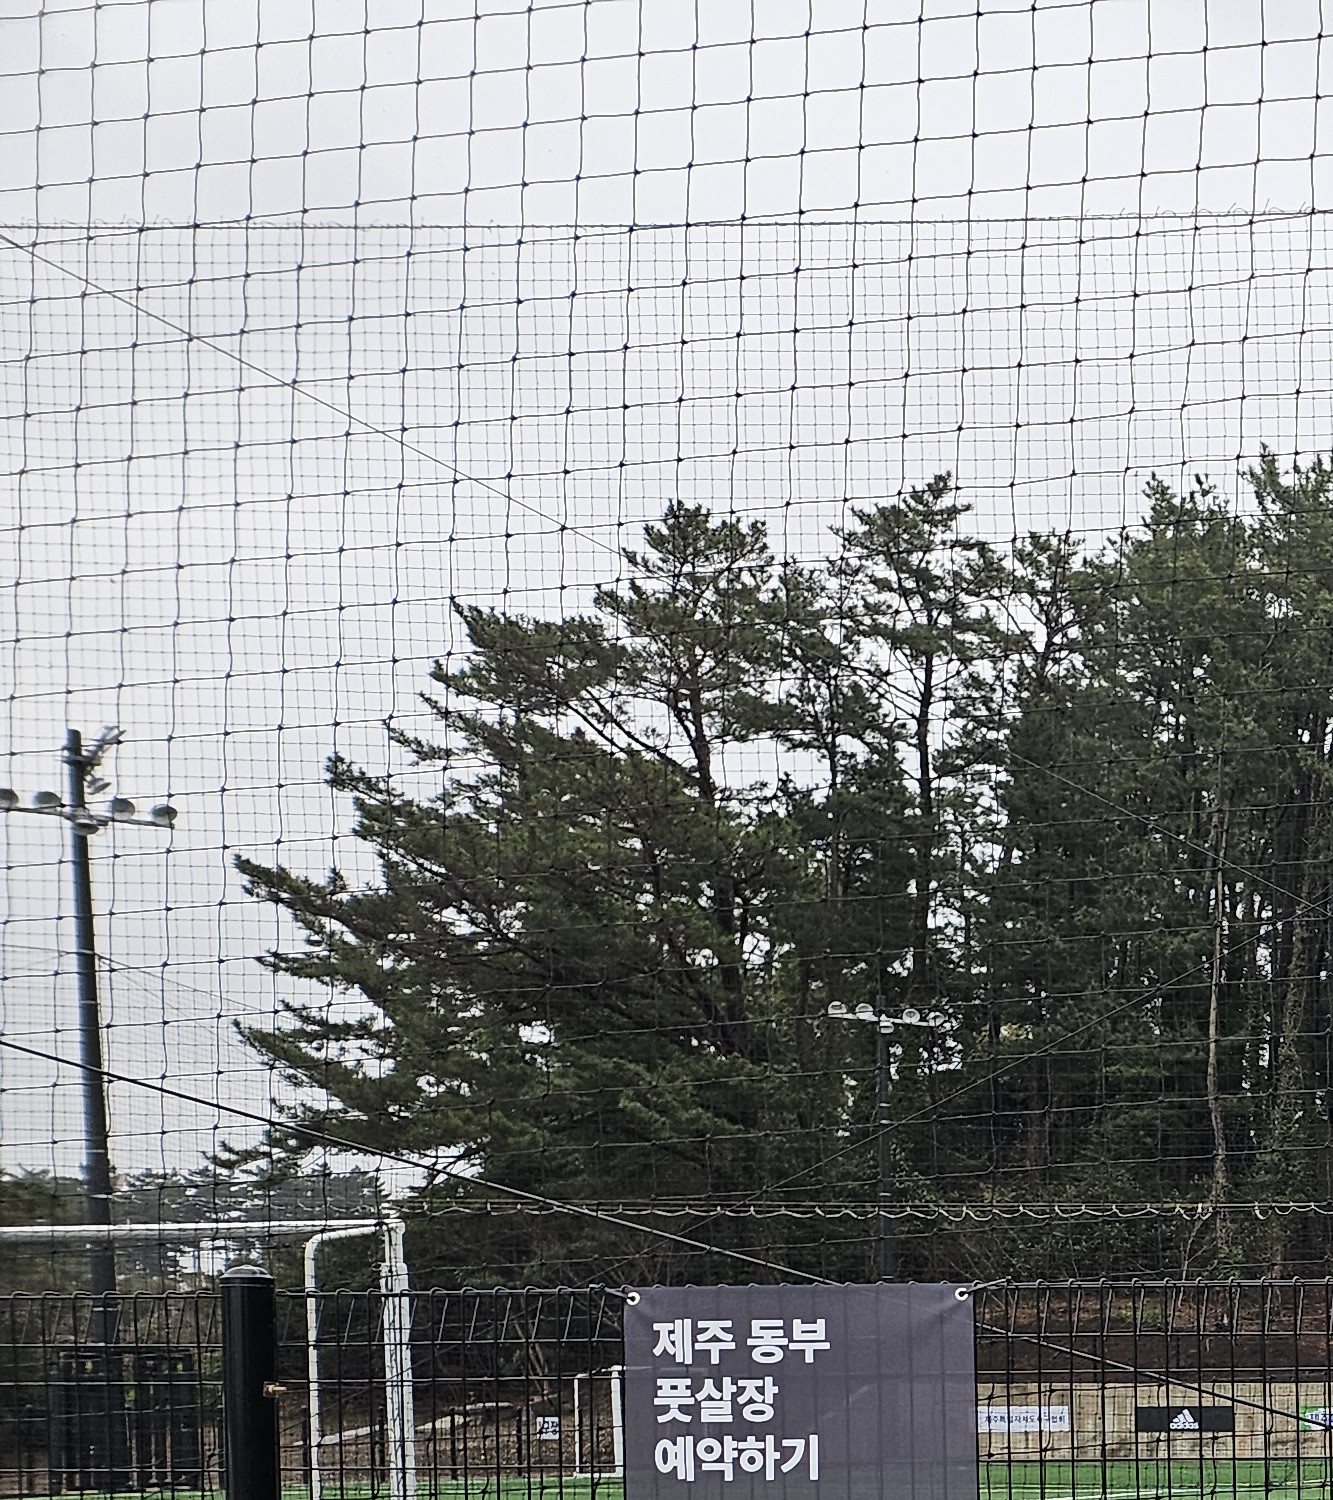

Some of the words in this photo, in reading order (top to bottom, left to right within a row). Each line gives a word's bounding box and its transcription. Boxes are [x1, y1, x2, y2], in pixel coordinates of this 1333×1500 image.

[652, 1318, 736, 1364] 제주
[746, 1318, 831, 1363] 동부
[653, 1376, 779, 1423] 풋살장
[654, 1434, 819, 1482] 예약하기
